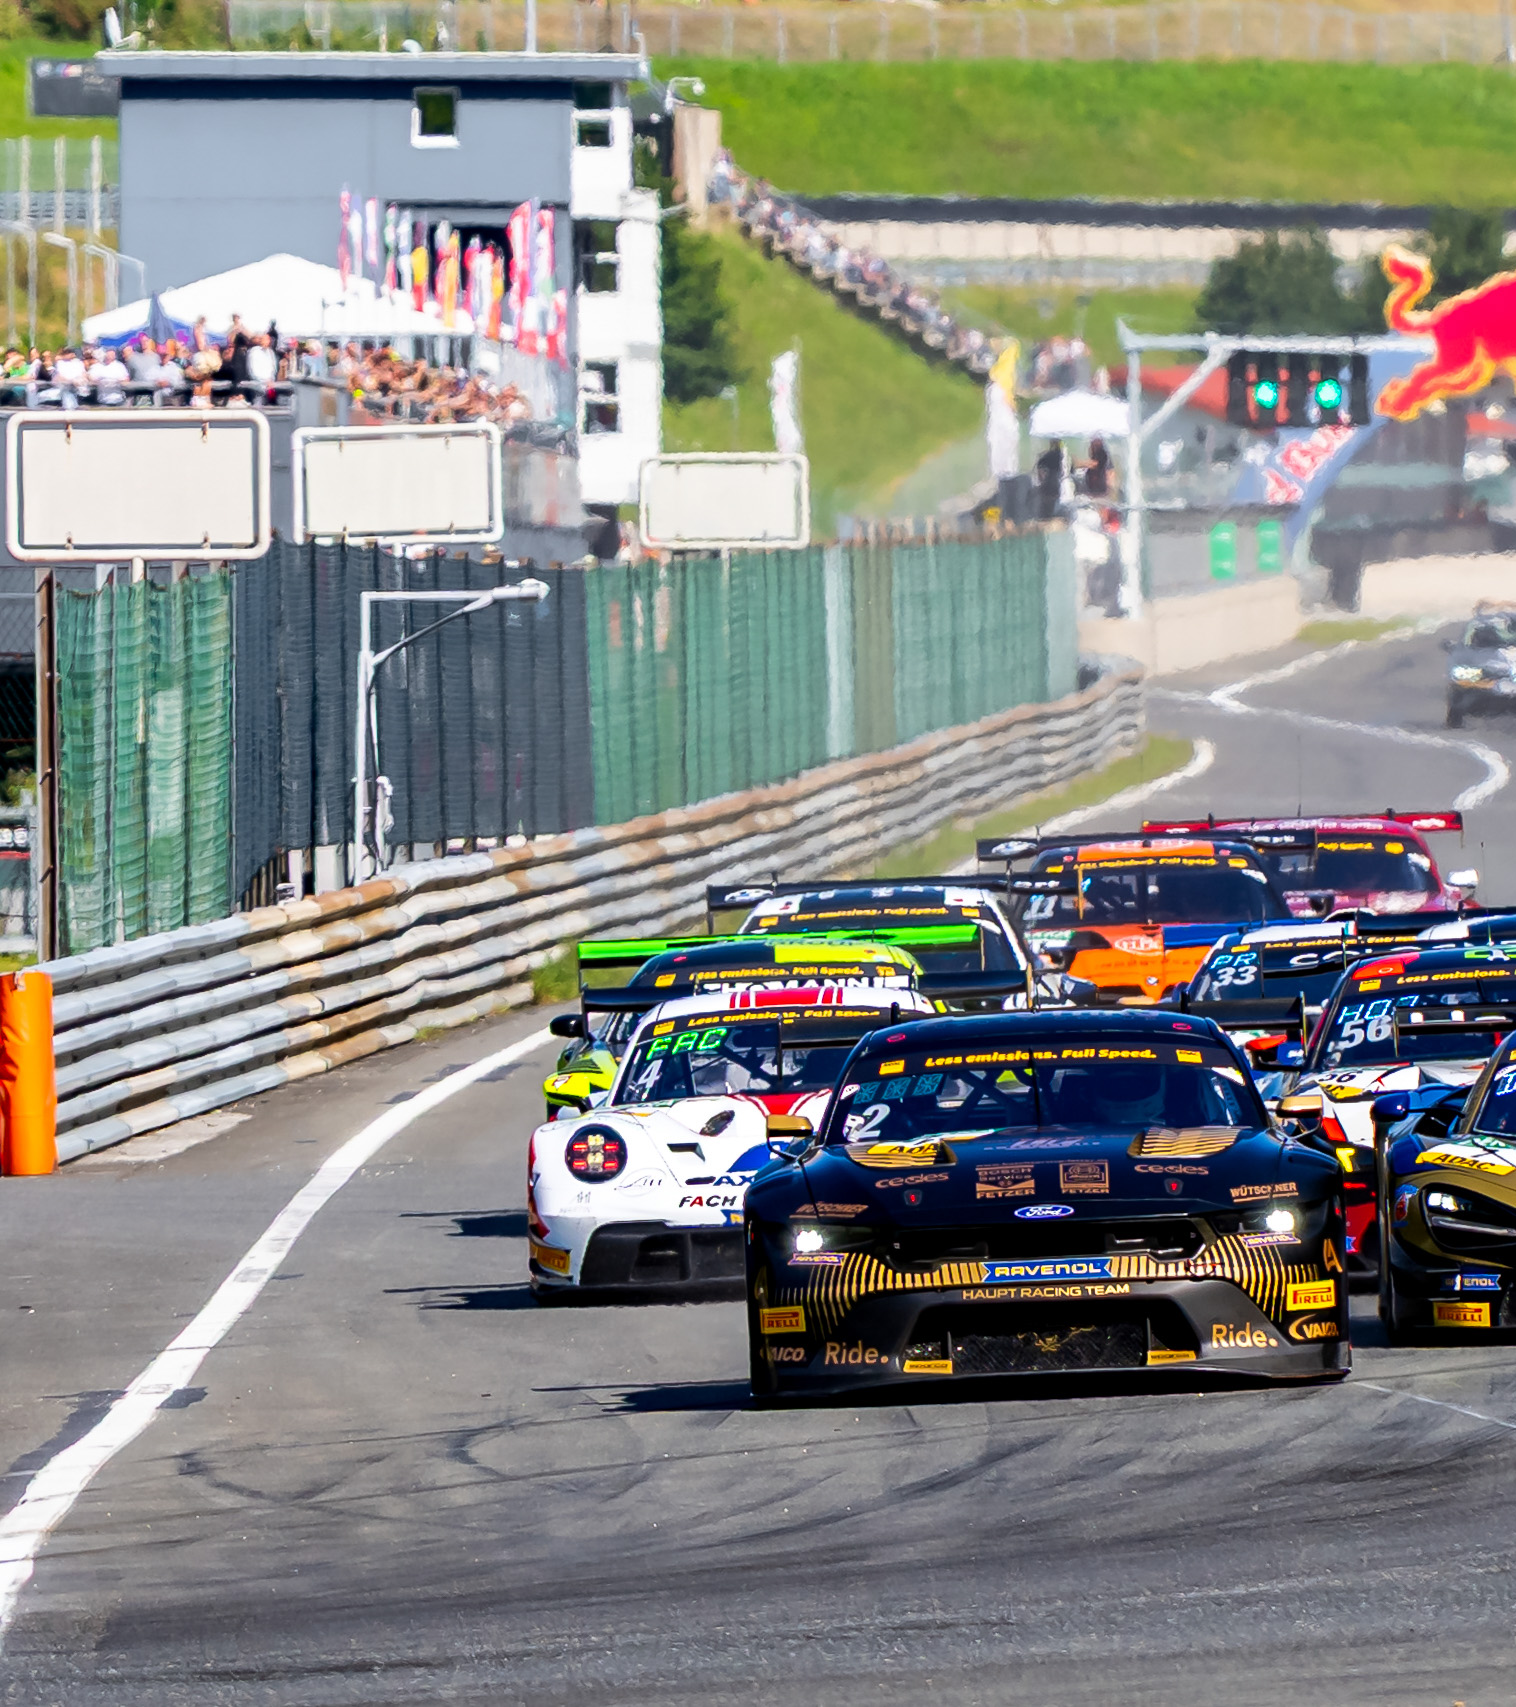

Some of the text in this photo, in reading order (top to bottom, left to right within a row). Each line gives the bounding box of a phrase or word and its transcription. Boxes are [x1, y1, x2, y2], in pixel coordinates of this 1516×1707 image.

[1212, 965, 1258, 987] 33
[1339, 1014, 1393, 1049] 56
[646, 1028, 728, 1060] FAC
[925, 1049, 1157, 1067] Less emissions. Full Speed.
[637, 1058, 663, 1088] 4
[858, 1104, 891, 1138] 2
[1435, 1153, 1497, 1171] ADAC
[678, 1195, 737, 1208] FACH
[976, 1188, 1036, 1199] FETZER
[1026, 1206, 1062, 1218] Ford
[994, 1262, 1101, 1277] RAVENOL
[962, 1283, 1130, 1300] HAUPT RACING TEAM
[1212, 1322, 1278, 1349] Ride.
[825, 1340, 889, 1364] Ride.
